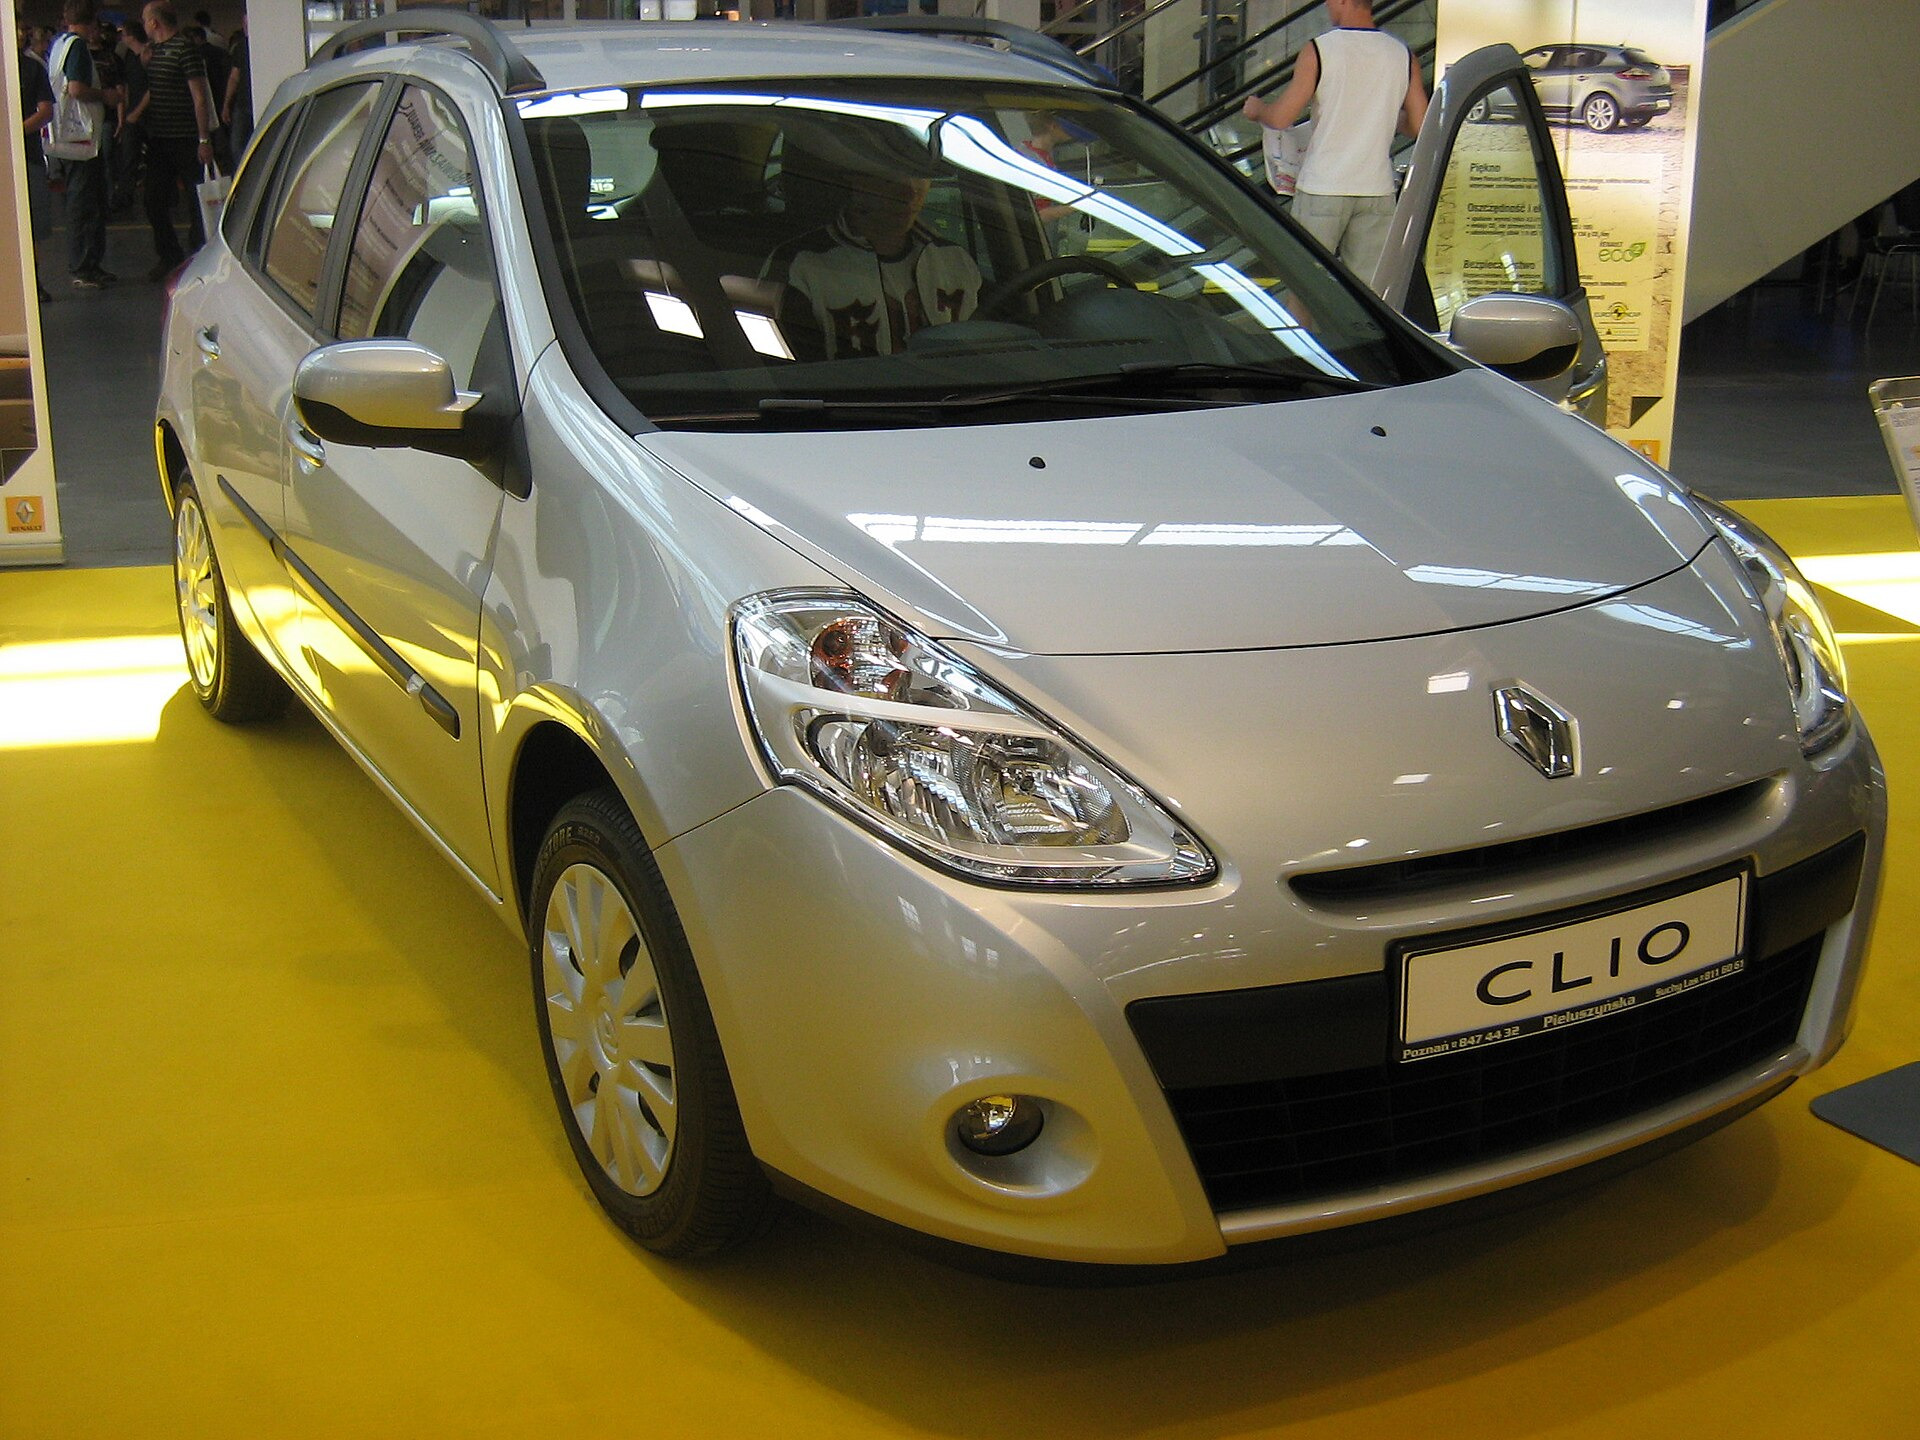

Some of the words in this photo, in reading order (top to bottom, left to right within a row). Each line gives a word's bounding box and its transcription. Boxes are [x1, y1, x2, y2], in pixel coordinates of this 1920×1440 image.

[1464, 260, 1536, 270] Bezpieczstwo
[1476, 921, 1690, 1006] CLIO
[1655, 982, 1683, 998] Suchy
[1683, 976, 1700, 988] Las
[1704, 967, 1720, 981] 811
[1543, 996, 1636, 1028] Pieluszyńska
[1402, 1040, 1449, 1059] Poznań
[1458, 1033, 1483, 1048] 847
[1484, 1030, 1502, 1042] 44
[1503, 1026, 1520, 1038] 32
